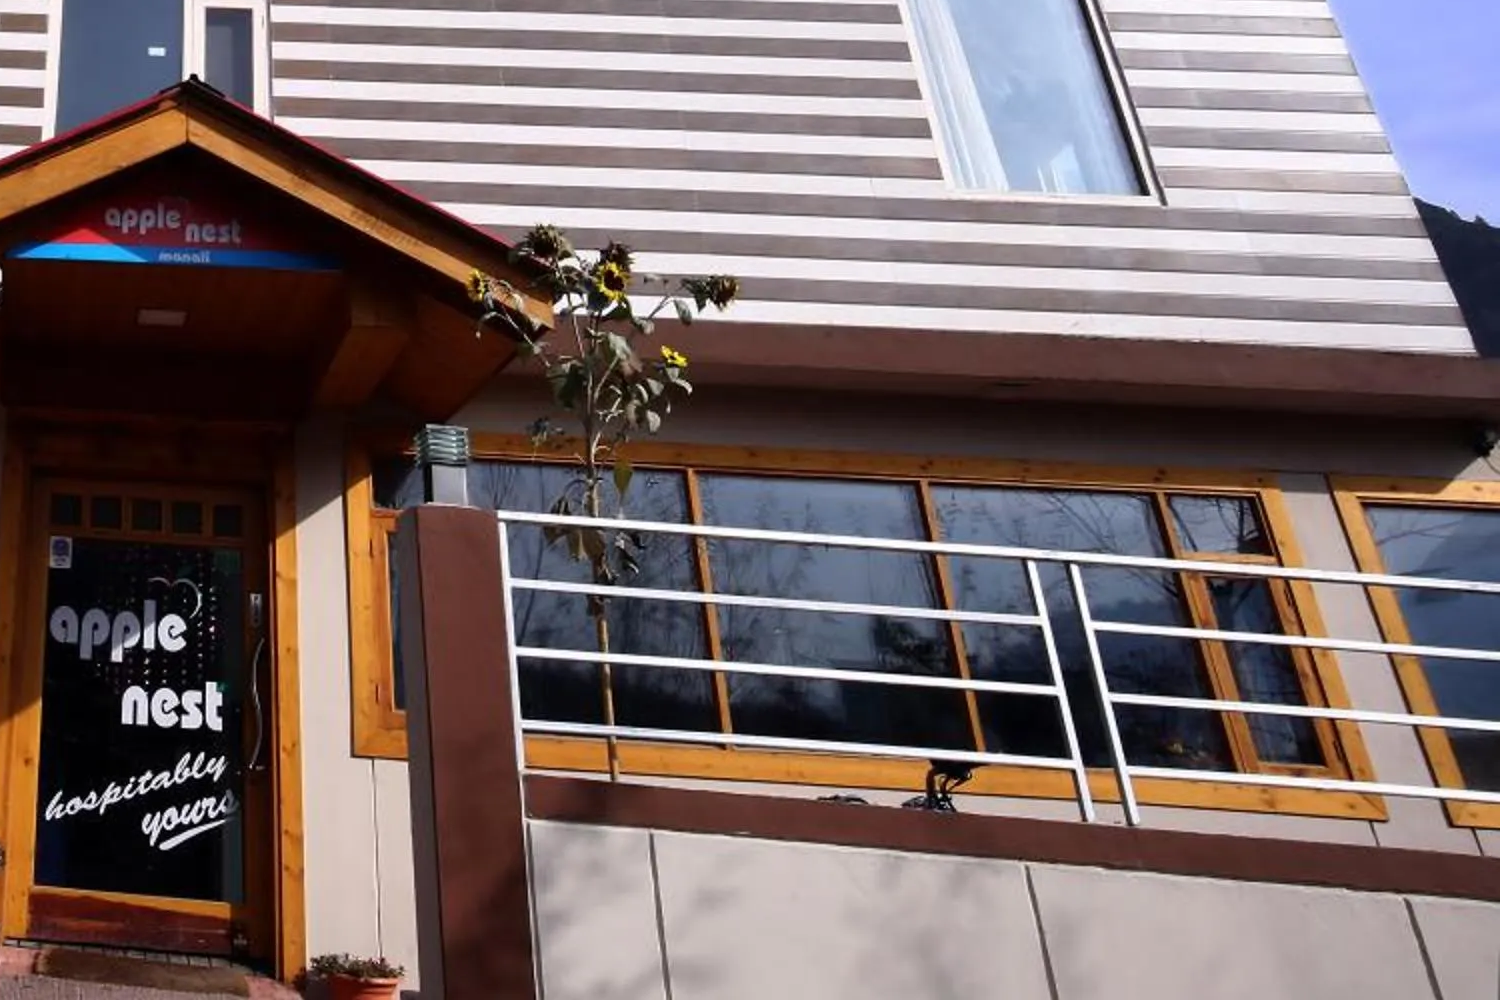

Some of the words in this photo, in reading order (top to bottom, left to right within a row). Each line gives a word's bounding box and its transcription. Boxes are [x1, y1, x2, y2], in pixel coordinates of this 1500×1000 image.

[104, 202, 181, 235] apple
[185, 219, 241, 243] nest
[158, 249, 211, 263] manali
[49, 599, 188, 663] apple
[121, 681, 223, 731] nest
[45, 752, 228, 821] hospitably
